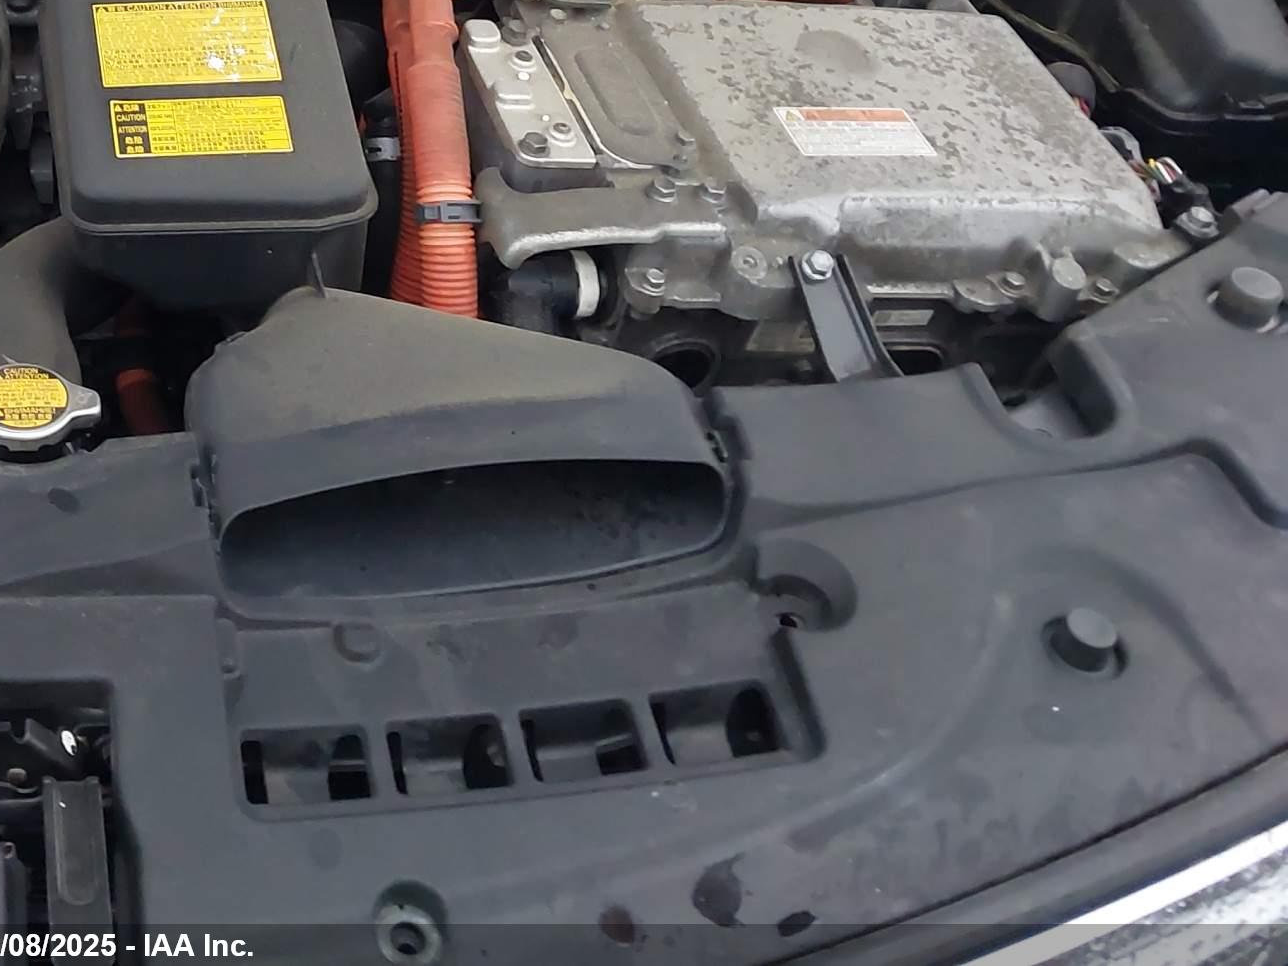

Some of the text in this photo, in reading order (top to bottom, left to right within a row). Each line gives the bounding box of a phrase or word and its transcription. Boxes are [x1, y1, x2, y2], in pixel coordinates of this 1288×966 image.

[128, 4, 165, 12] CAUTION
[168, 1, 217, 11] ATTENTION
[116, 113, 146, 122] CAUTION
[118, 125, 147, 134] ATTENTION
[3, 367, 39, 375] CAUTION
[4, 372, 49, 380] ATTENTION
